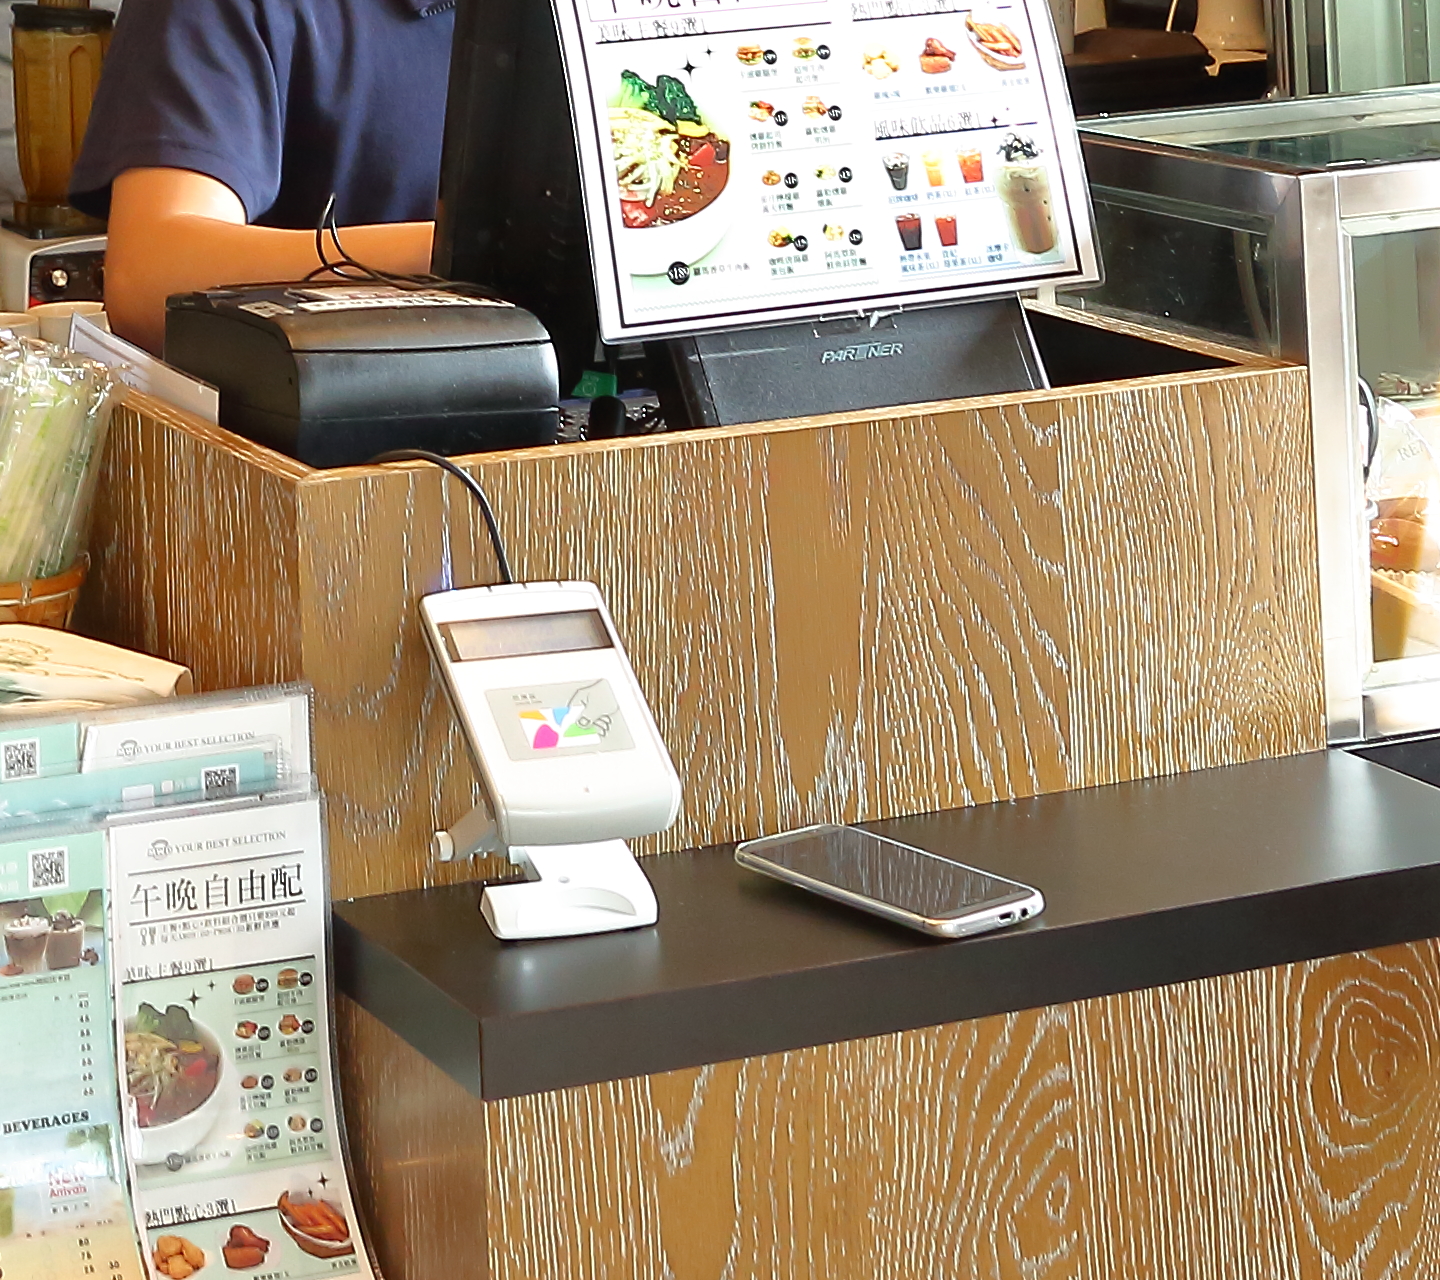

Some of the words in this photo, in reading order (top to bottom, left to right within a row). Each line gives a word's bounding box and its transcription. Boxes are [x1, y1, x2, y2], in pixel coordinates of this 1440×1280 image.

[821, 342, 904, 366] PARTNER
[176, 842, 204, 854] YOUR
[206, 838, 230, 851] BEST
[130, 862, 304, 919] 午晚自由配
[3, 1109, 91, 1136] BEVERAGES
